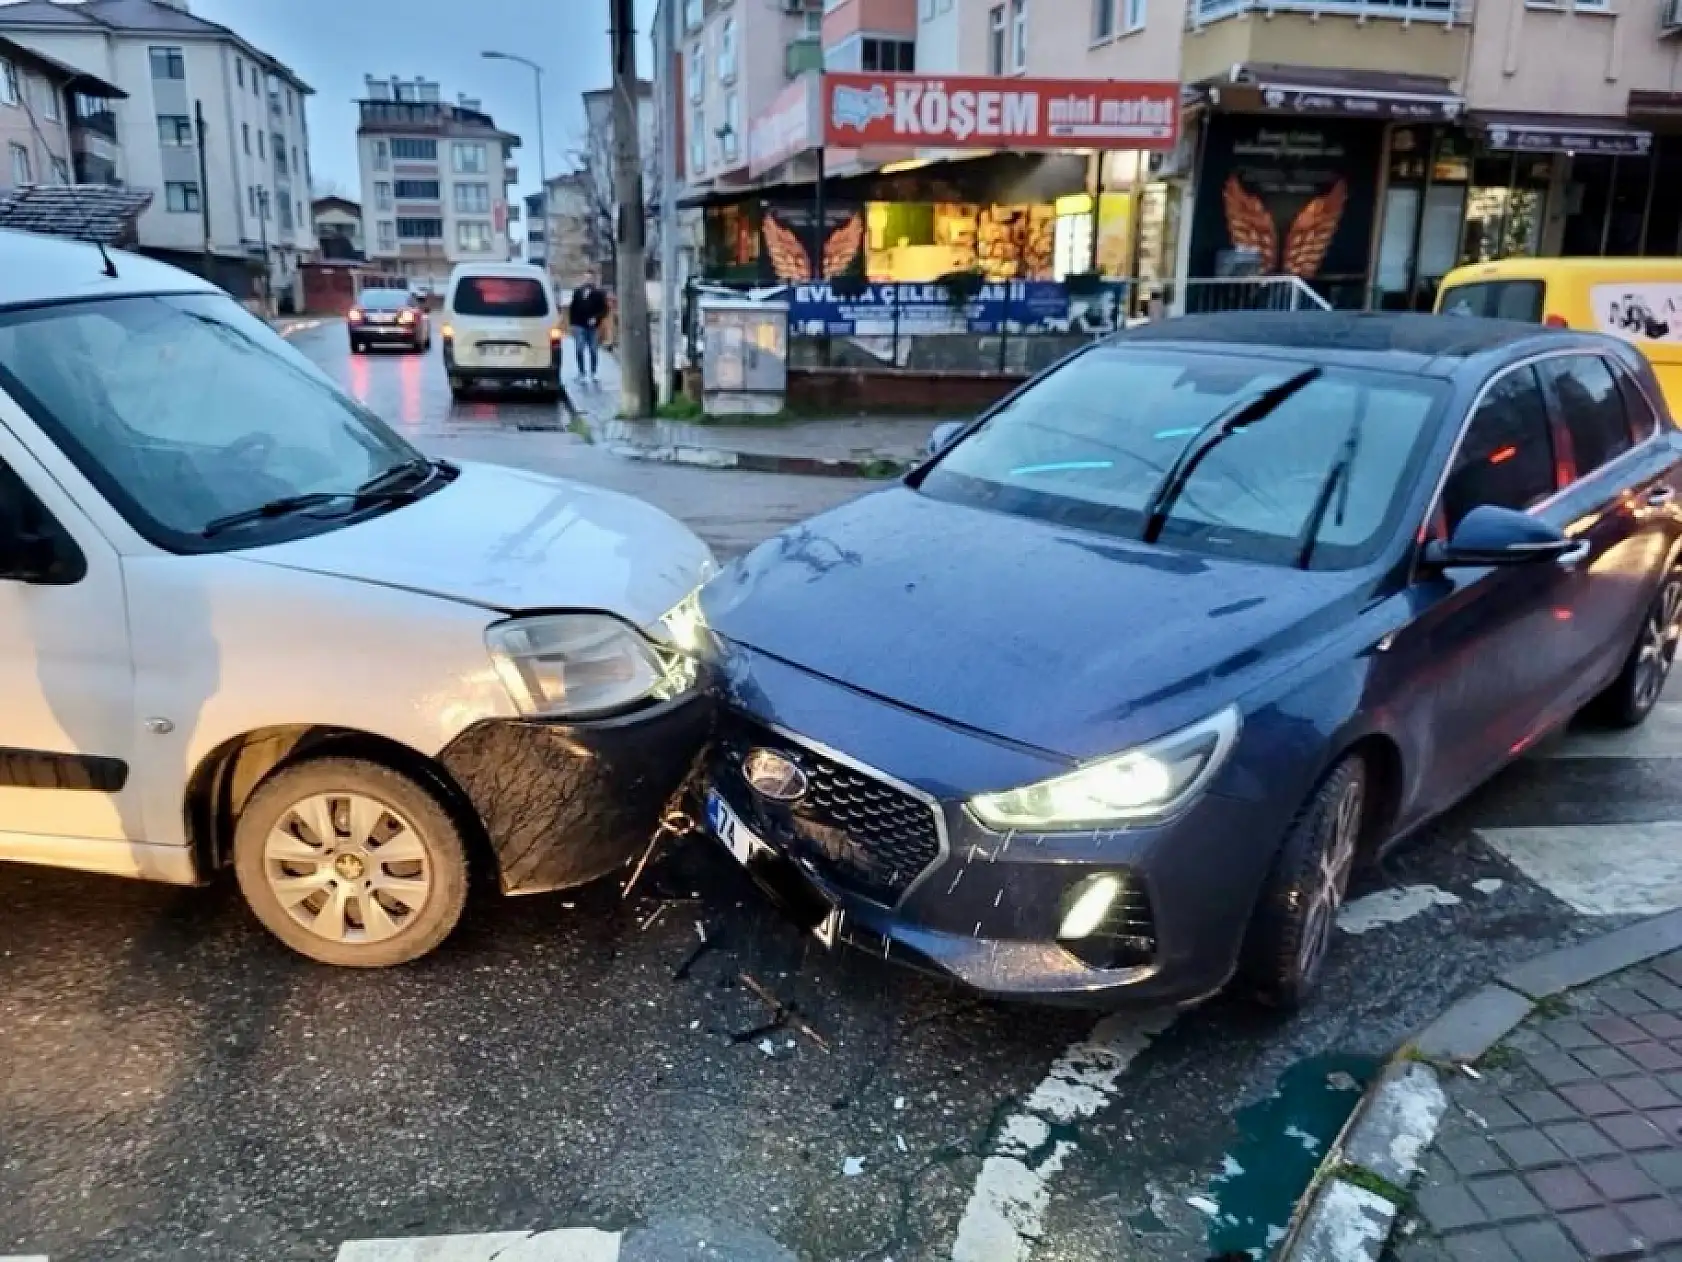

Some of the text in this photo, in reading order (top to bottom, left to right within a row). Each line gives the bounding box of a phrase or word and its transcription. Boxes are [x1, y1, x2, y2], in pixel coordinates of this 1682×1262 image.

[893, 81, 1174, 141] KÖŞEM mini market
[796, 285, 875, 303] EVLA
